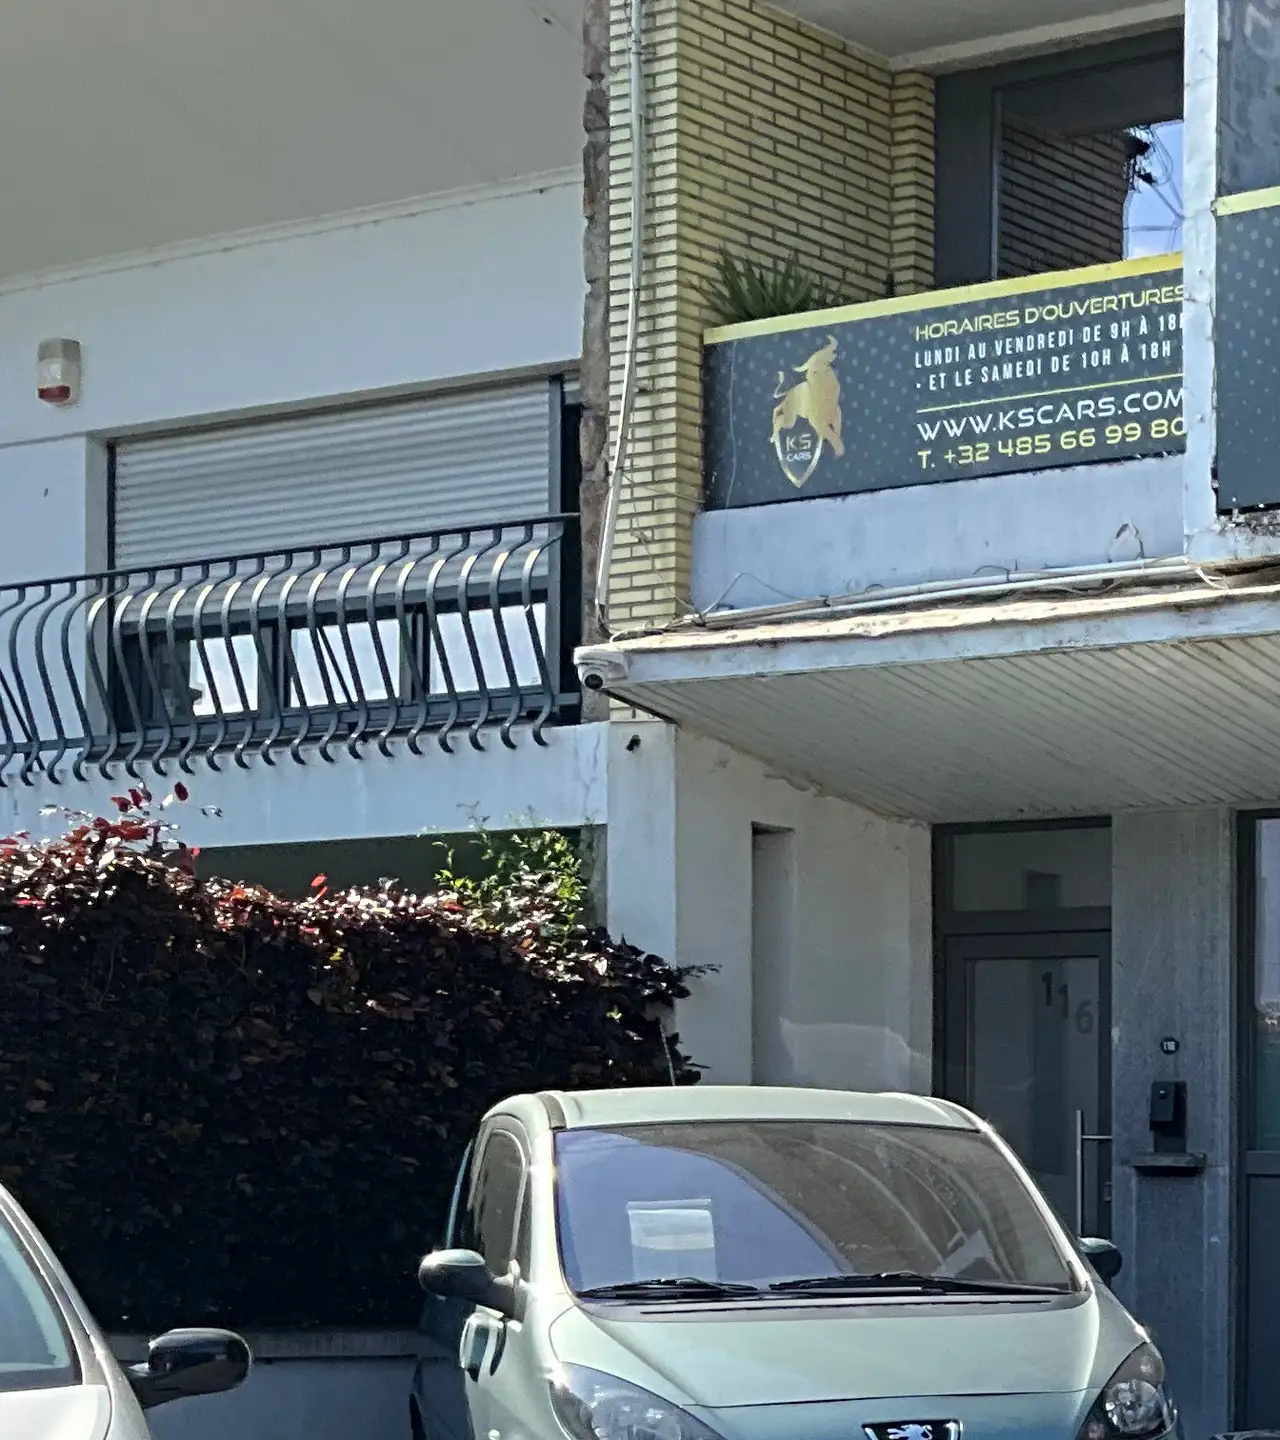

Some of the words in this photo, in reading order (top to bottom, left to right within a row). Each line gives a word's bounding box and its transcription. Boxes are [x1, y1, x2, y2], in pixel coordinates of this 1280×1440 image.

[915, 309, 1020, 341] HORAIRES
[915, 346, 960, 368] LUNDI
[968, 342, 986, 359] AU
[994, 329, 1074, 356] VENDREDI
[1082, 325, 1101, 343] DE
[1110, 320, 1130, 339] 9H
[1139, 314, 1148, 335] À
[929, 373, 946, 391] ET
[955, 368, 972, 387] LE
[981, 358, 1041, 383] SAMEDI
[1051, 354, 1070, 373] DE
[1081, 348, 1111, 368] 10H
[1121, 343, 1129, 363] À
[1141, 340, 1171, 360] 18H
[916, 387, 1184, 441] WWW.KSCARS.COM
[917, 449, 936, 469] T.
[944, 442, 990, 465] +32
[998, 433, 1051, 457] 485
[1060, 428, 1096, 448] 66
[1105, 423, 1141, 444] 99
[1151, 416, 1185, 438] 80
